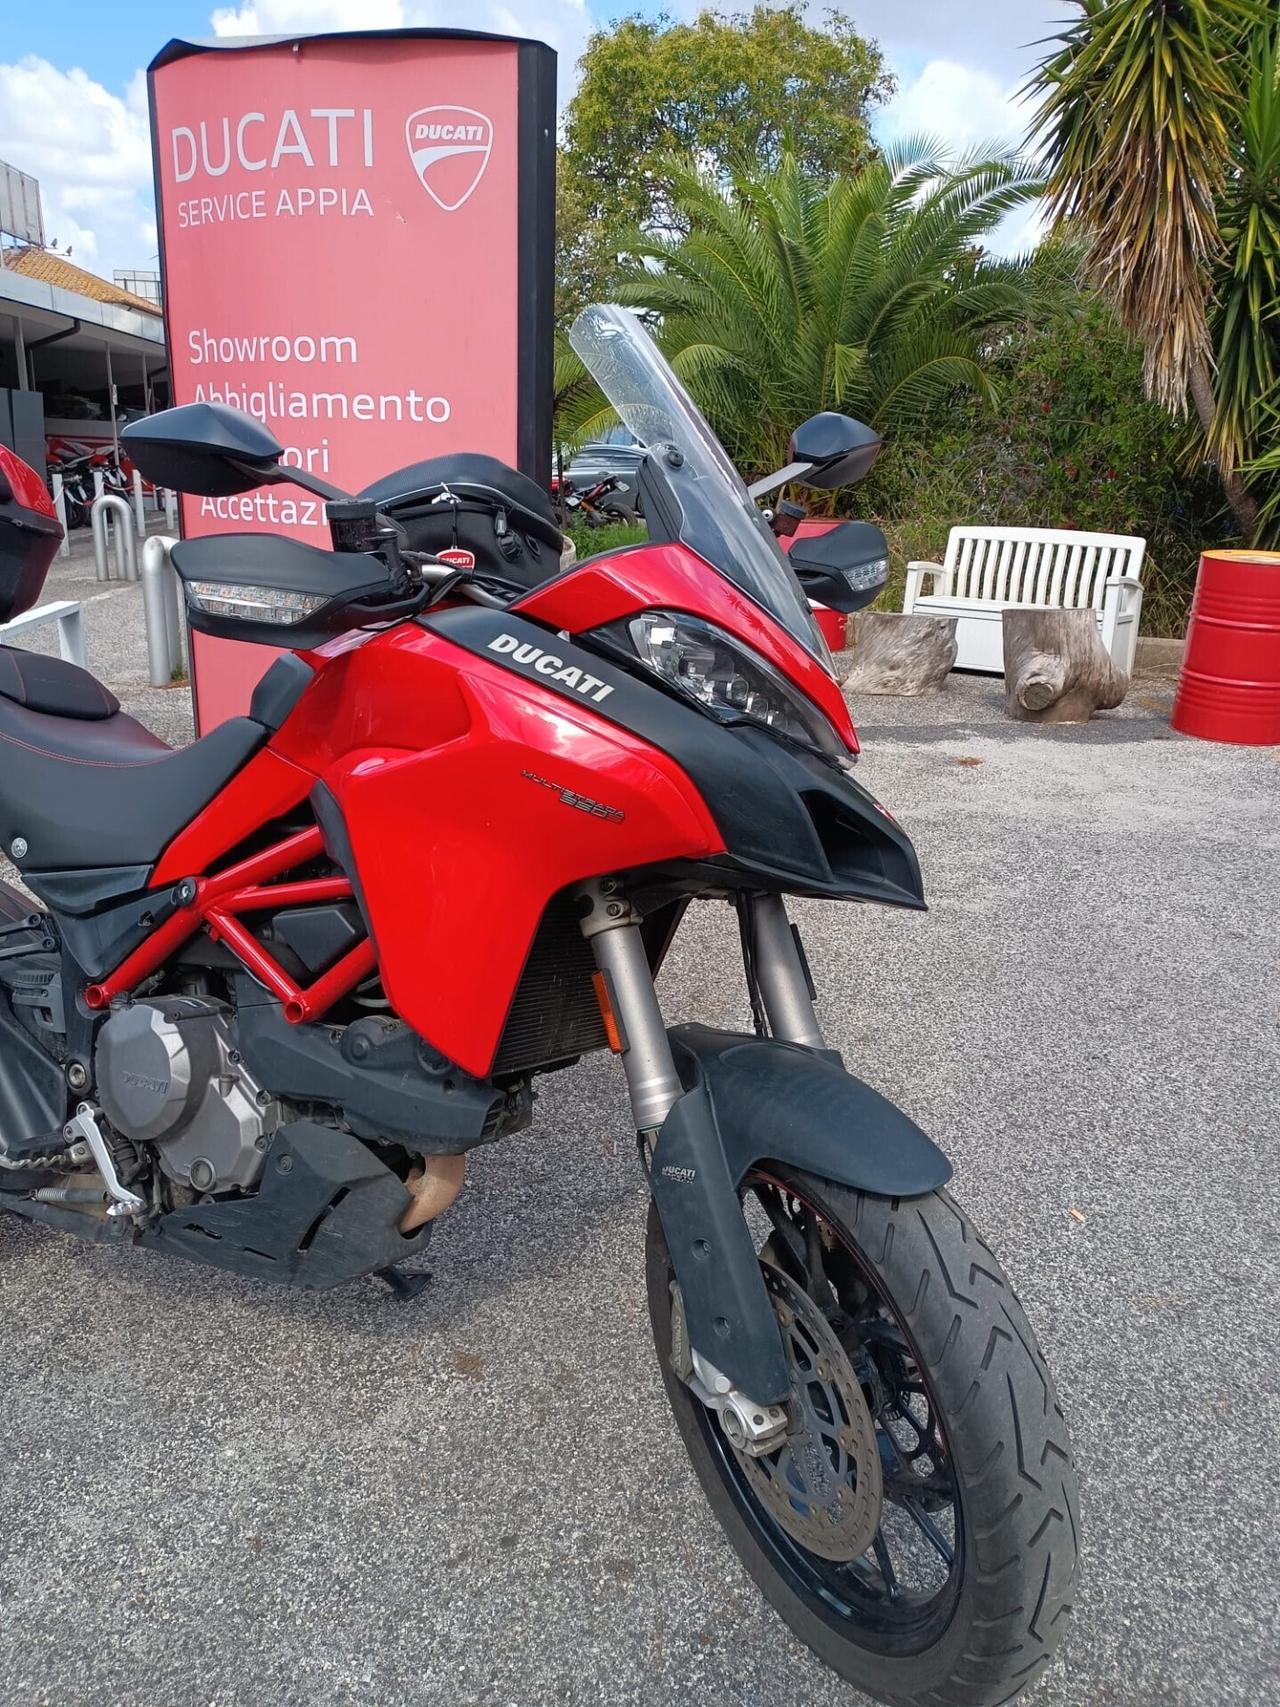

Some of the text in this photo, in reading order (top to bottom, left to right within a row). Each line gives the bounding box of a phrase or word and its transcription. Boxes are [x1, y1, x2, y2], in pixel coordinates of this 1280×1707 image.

[171, 108, 373, 183] DUCATI
[415, 123, 484, 141] DUCATI
[178, 188, 375, 228] SERVICE APPIA
[188, 328, 358, 365] Showroom
[200, 492, 329, 527] Accettazi
[487, 633, 615, 702] DUCATI
